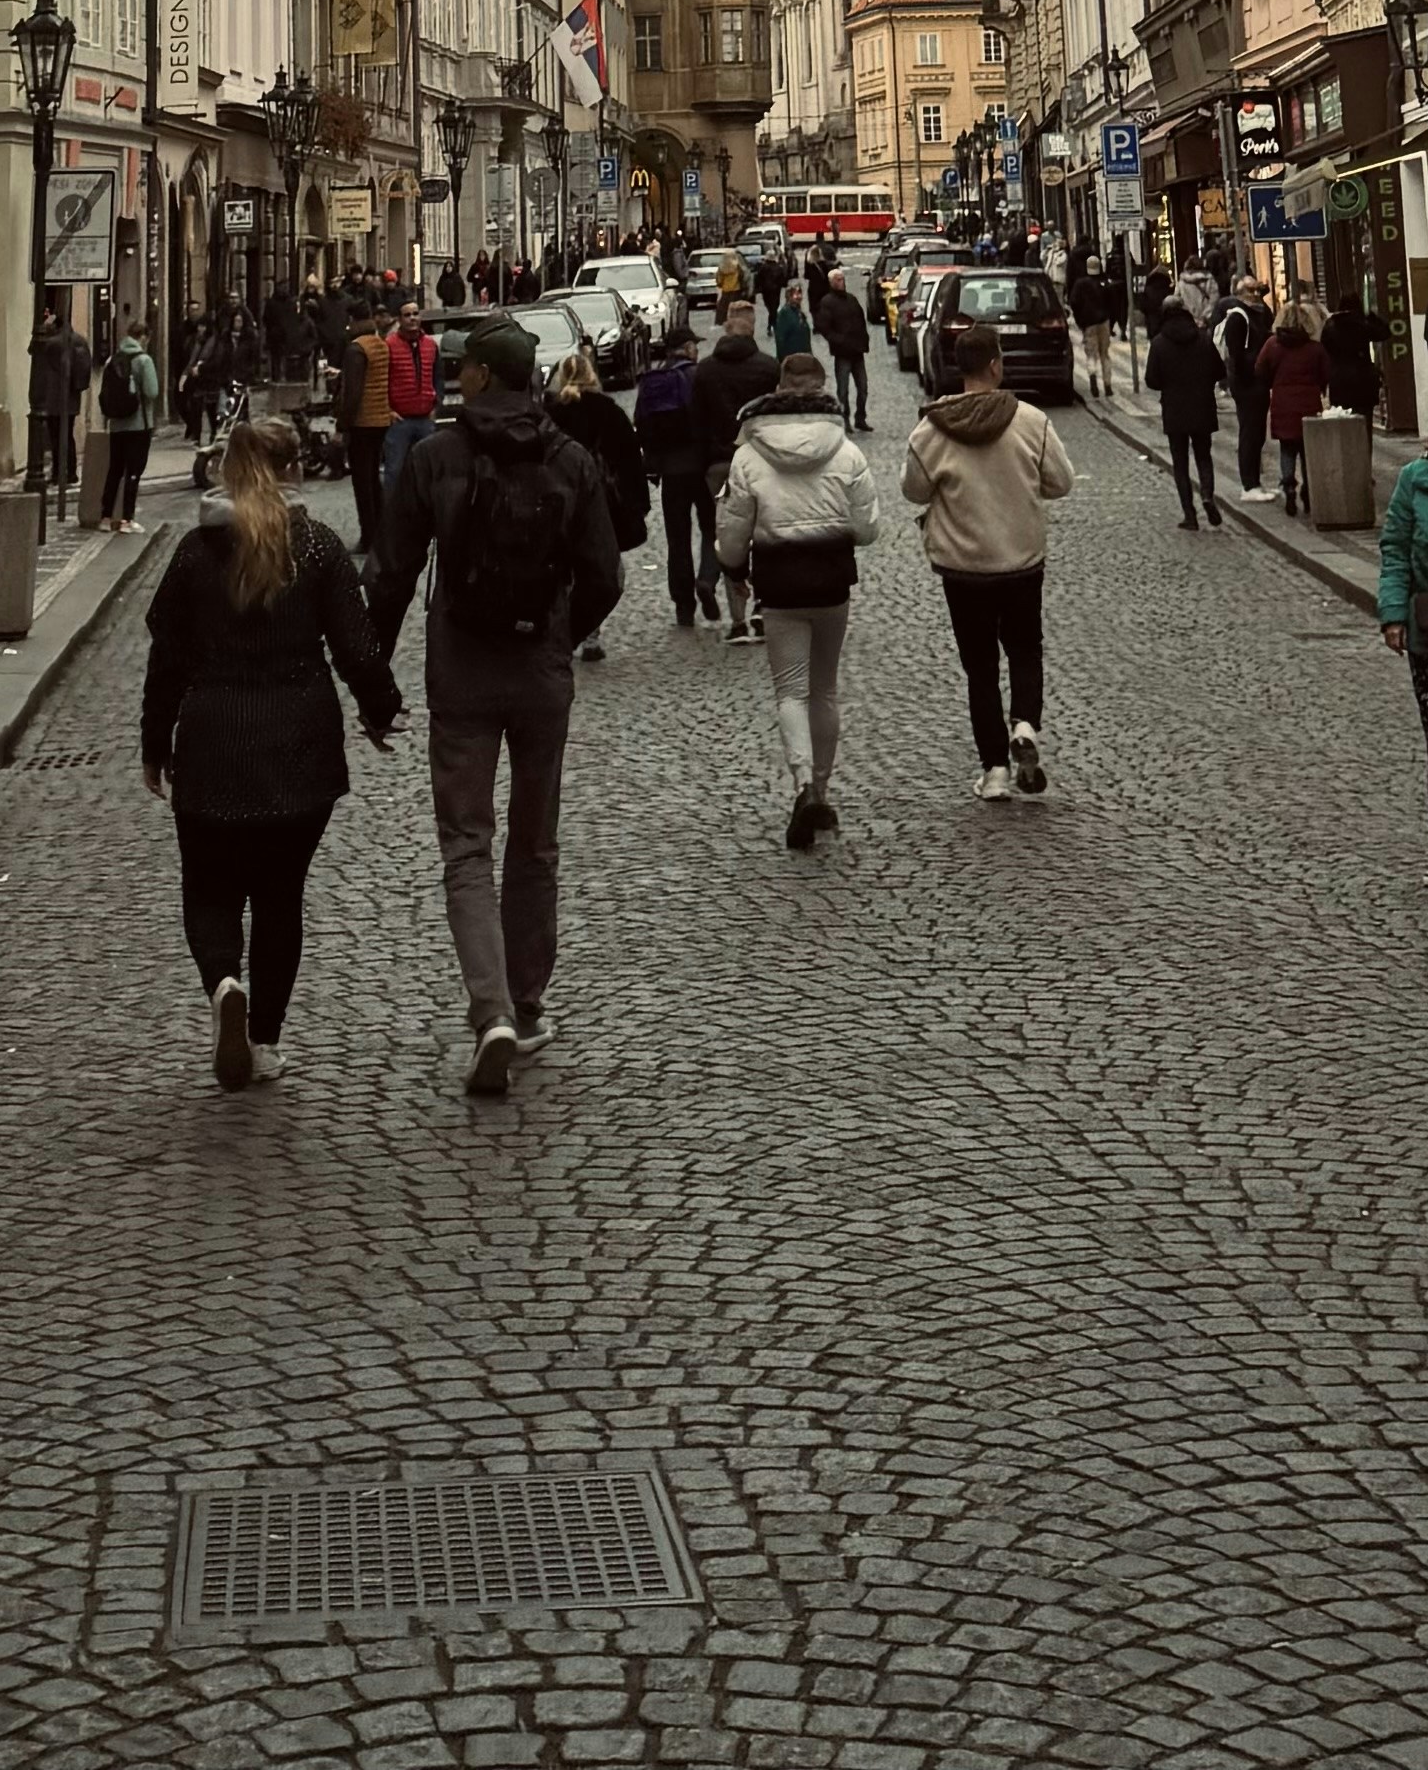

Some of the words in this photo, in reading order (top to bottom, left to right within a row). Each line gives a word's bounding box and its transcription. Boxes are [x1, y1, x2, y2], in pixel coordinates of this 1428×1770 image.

[1110, 129, 1131, 161] P
[600, 161, 613, 179] P
[1007, 156, 1017, 172] P
[687, 173, 697, 187] P
[1377, 163, 1398, 241] EED
[1387, 272, 1408, 359] SHOP
